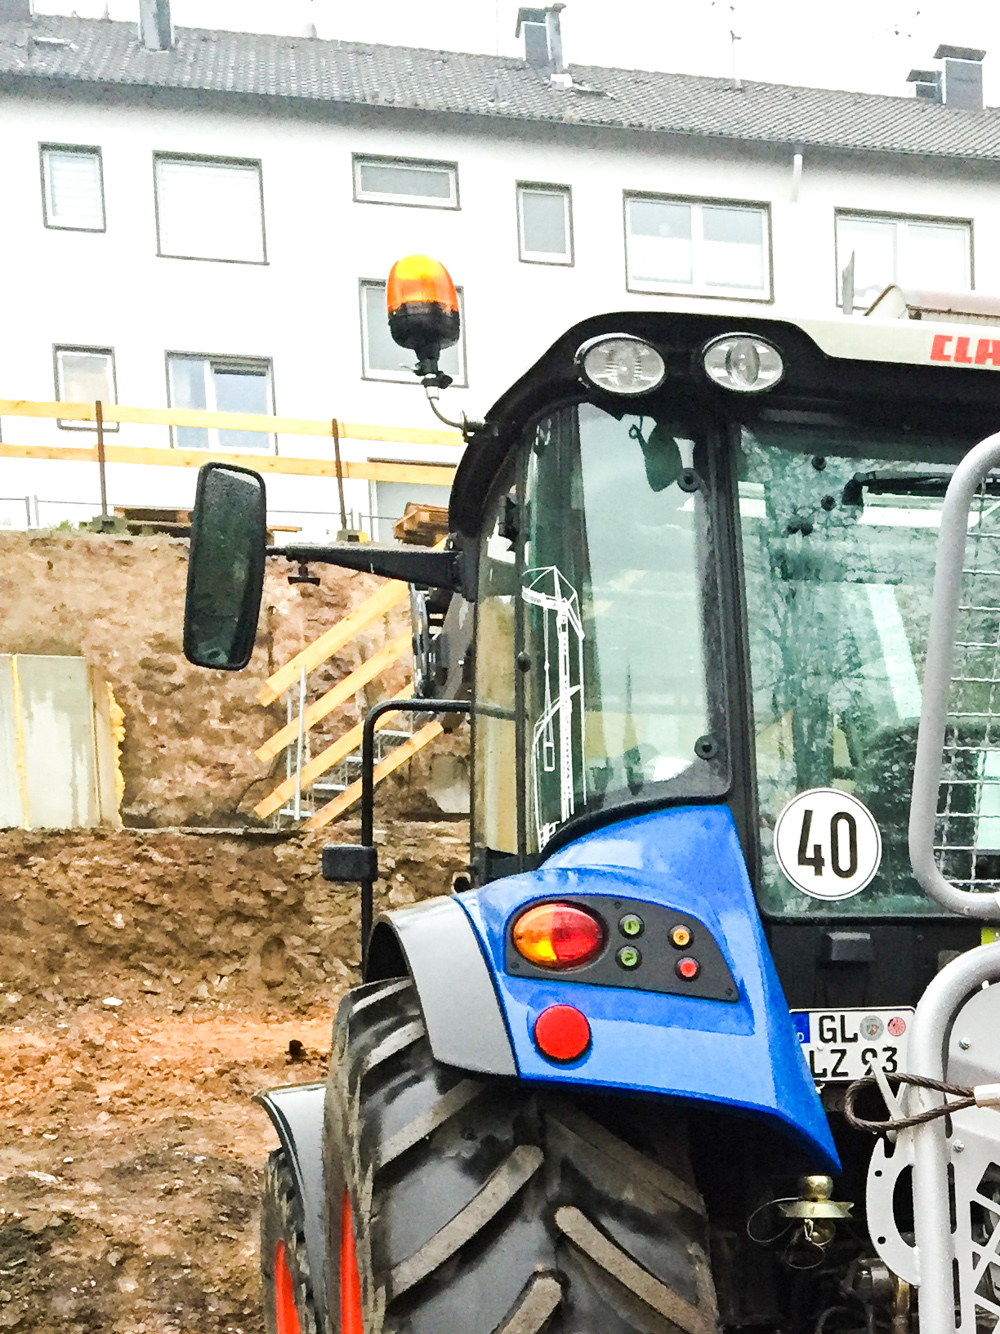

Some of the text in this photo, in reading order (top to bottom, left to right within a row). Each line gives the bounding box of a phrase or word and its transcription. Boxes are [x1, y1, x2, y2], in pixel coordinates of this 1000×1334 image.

[797, 809, 858, 879] 40
[818, 1014, 859, 1044] GL
[808, 1046, 898, 1078] LZ 93
